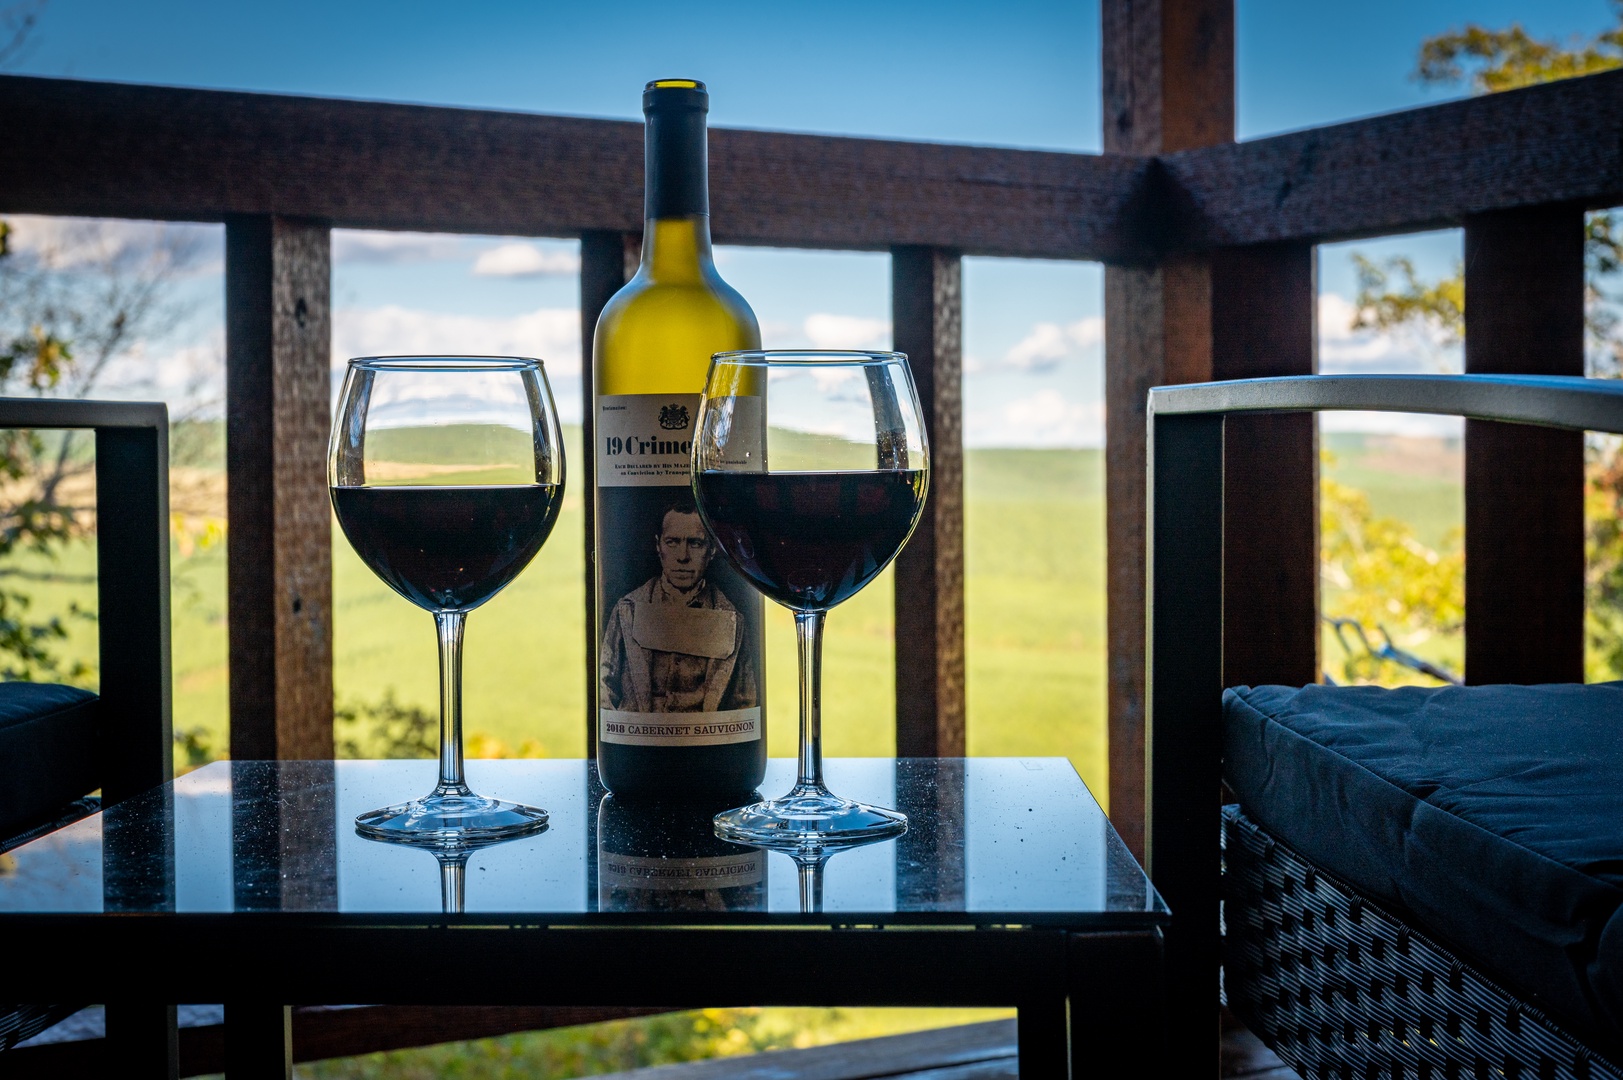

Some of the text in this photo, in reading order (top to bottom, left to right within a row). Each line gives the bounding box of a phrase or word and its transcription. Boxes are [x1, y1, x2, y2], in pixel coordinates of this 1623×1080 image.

[606, 435, 692, 456] 19 Crime
[606, 721, 755, 735] 2018 CABERNET SAUVIGNON
